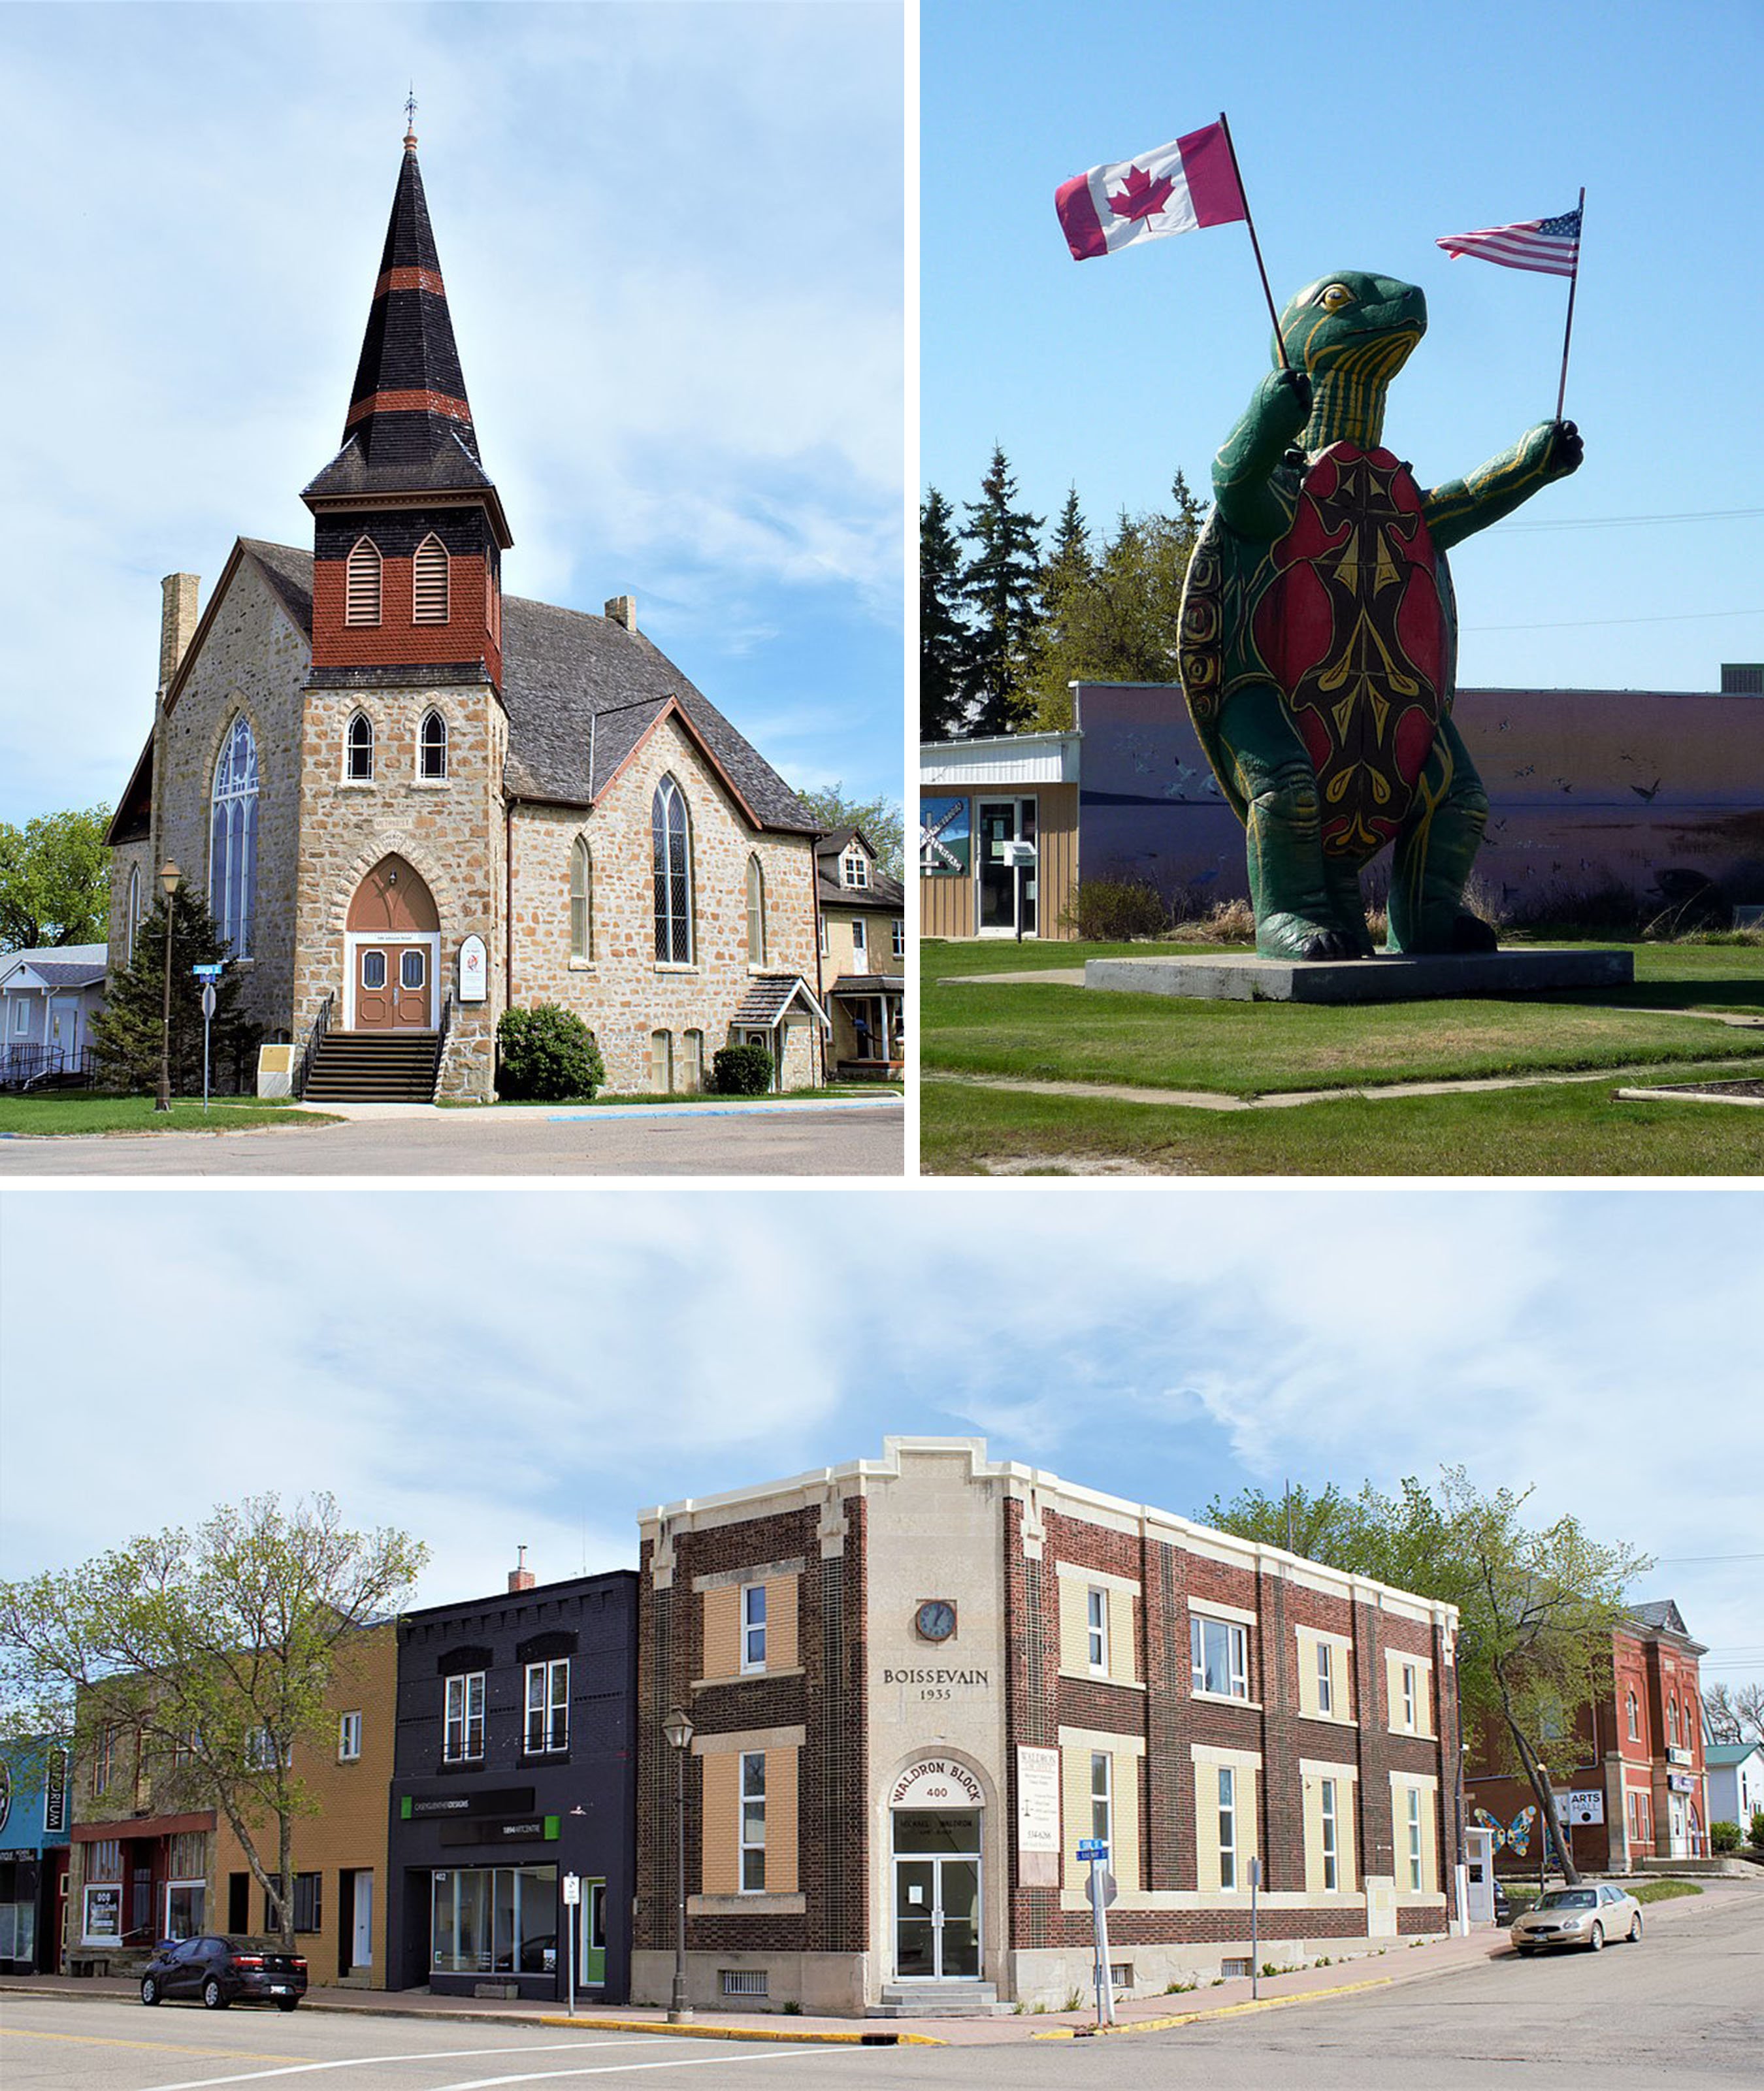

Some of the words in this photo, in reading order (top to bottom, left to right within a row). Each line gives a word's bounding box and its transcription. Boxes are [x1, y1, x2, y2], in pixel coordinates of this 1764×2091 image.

[884, 1670, 988, 1684] BOISSEVAIN
[921, 1689, 951, 1700] 1935
[1021, 1752, 1056, 1764] WALDRON
[893, 1762, 945, 1802] WALDRON
[950, 1766, 981, 1802] BLOCK
[927, 1788, 947, 1797] 400
[1571, 1794, 1600, 1803] ARTS
